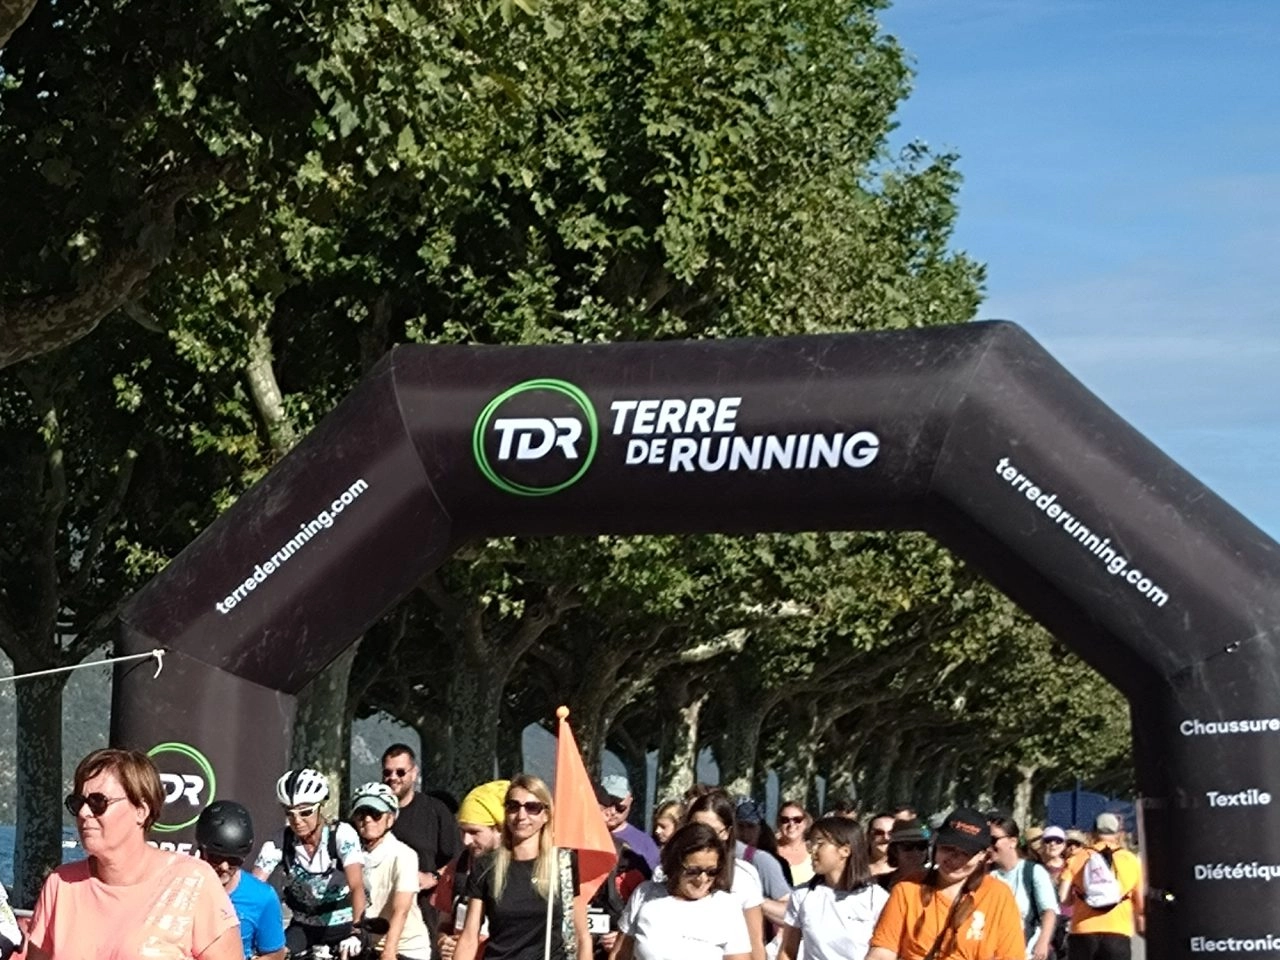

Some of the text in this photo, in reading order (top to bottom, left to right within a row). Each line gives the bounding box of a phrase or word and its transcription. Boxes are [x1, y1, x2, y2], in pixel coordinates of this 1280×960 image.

[610, 397, 742, 435] TERRE
[494, 418, 582, 460] TDR
[625, 431, 880, 473] DE RUNNING
[215, 478, 370, 615] terrederunning.com
[995, 456, 1169, 608] terrederunning.com
[1206, 789, 1271, 807] Textile
